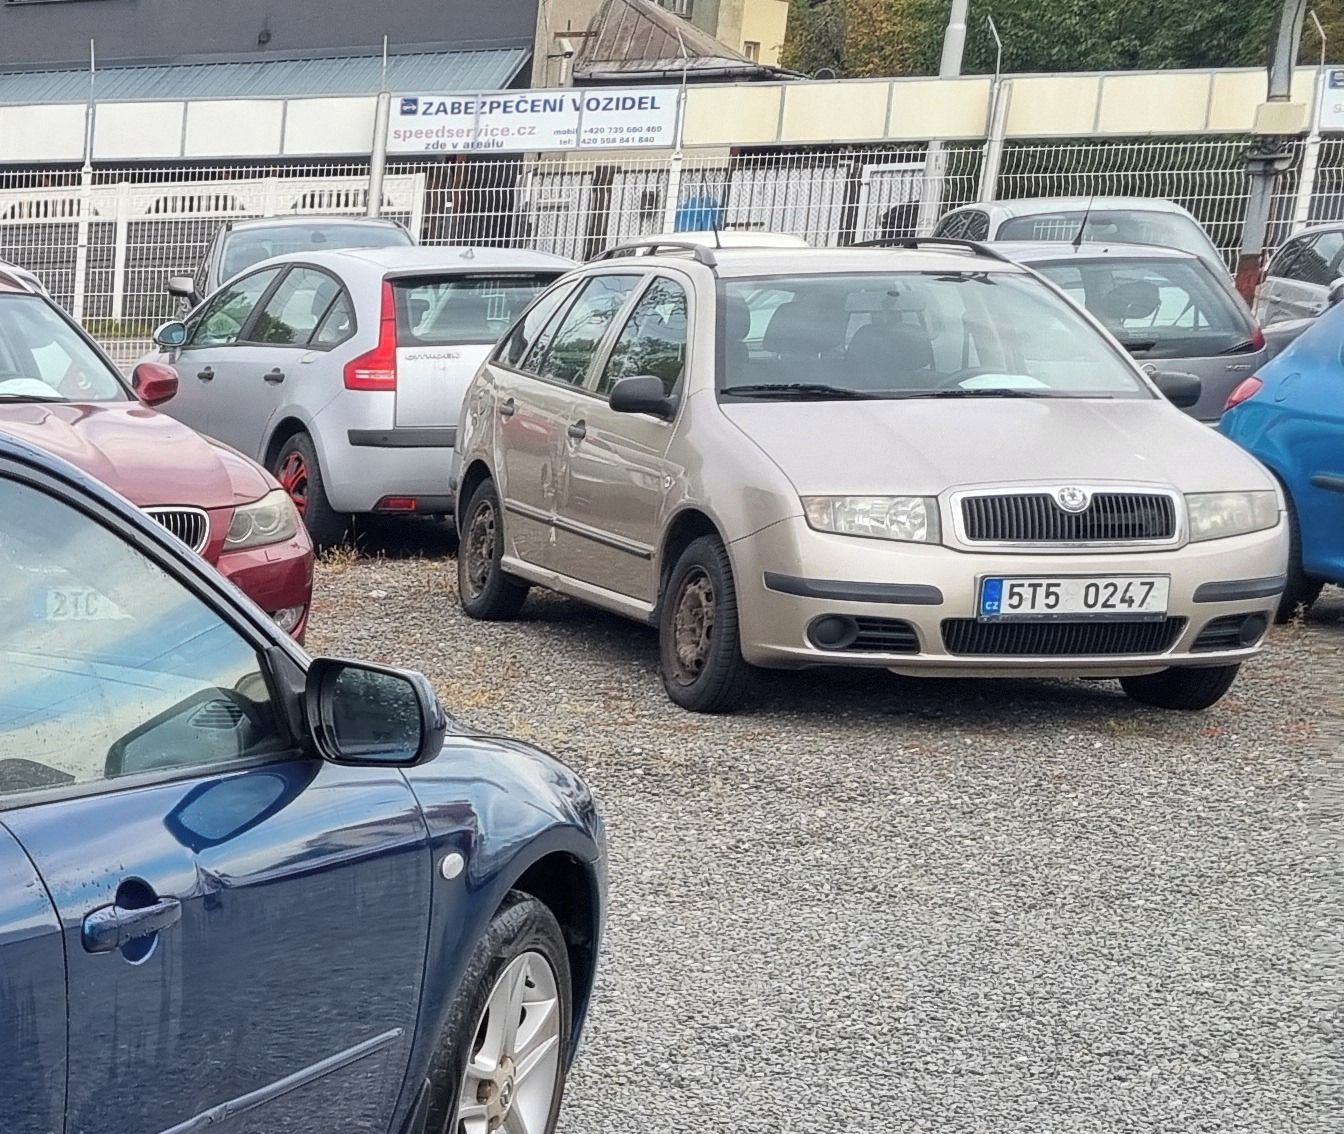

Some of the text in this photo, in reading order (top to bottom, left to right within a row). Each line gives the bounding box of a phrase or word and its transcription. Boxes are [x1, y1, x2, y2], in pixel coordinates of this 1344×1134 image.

[421, 95, 661, 116] ZABEZPEČENÍ VOZIDEL
[393, 125, 537, 141] speedservice.cz
[424, 139, 447, 151] zde
[451, 141, 459, 149] v
[985, 581, 1155, 610] CZ 5T5 0247
